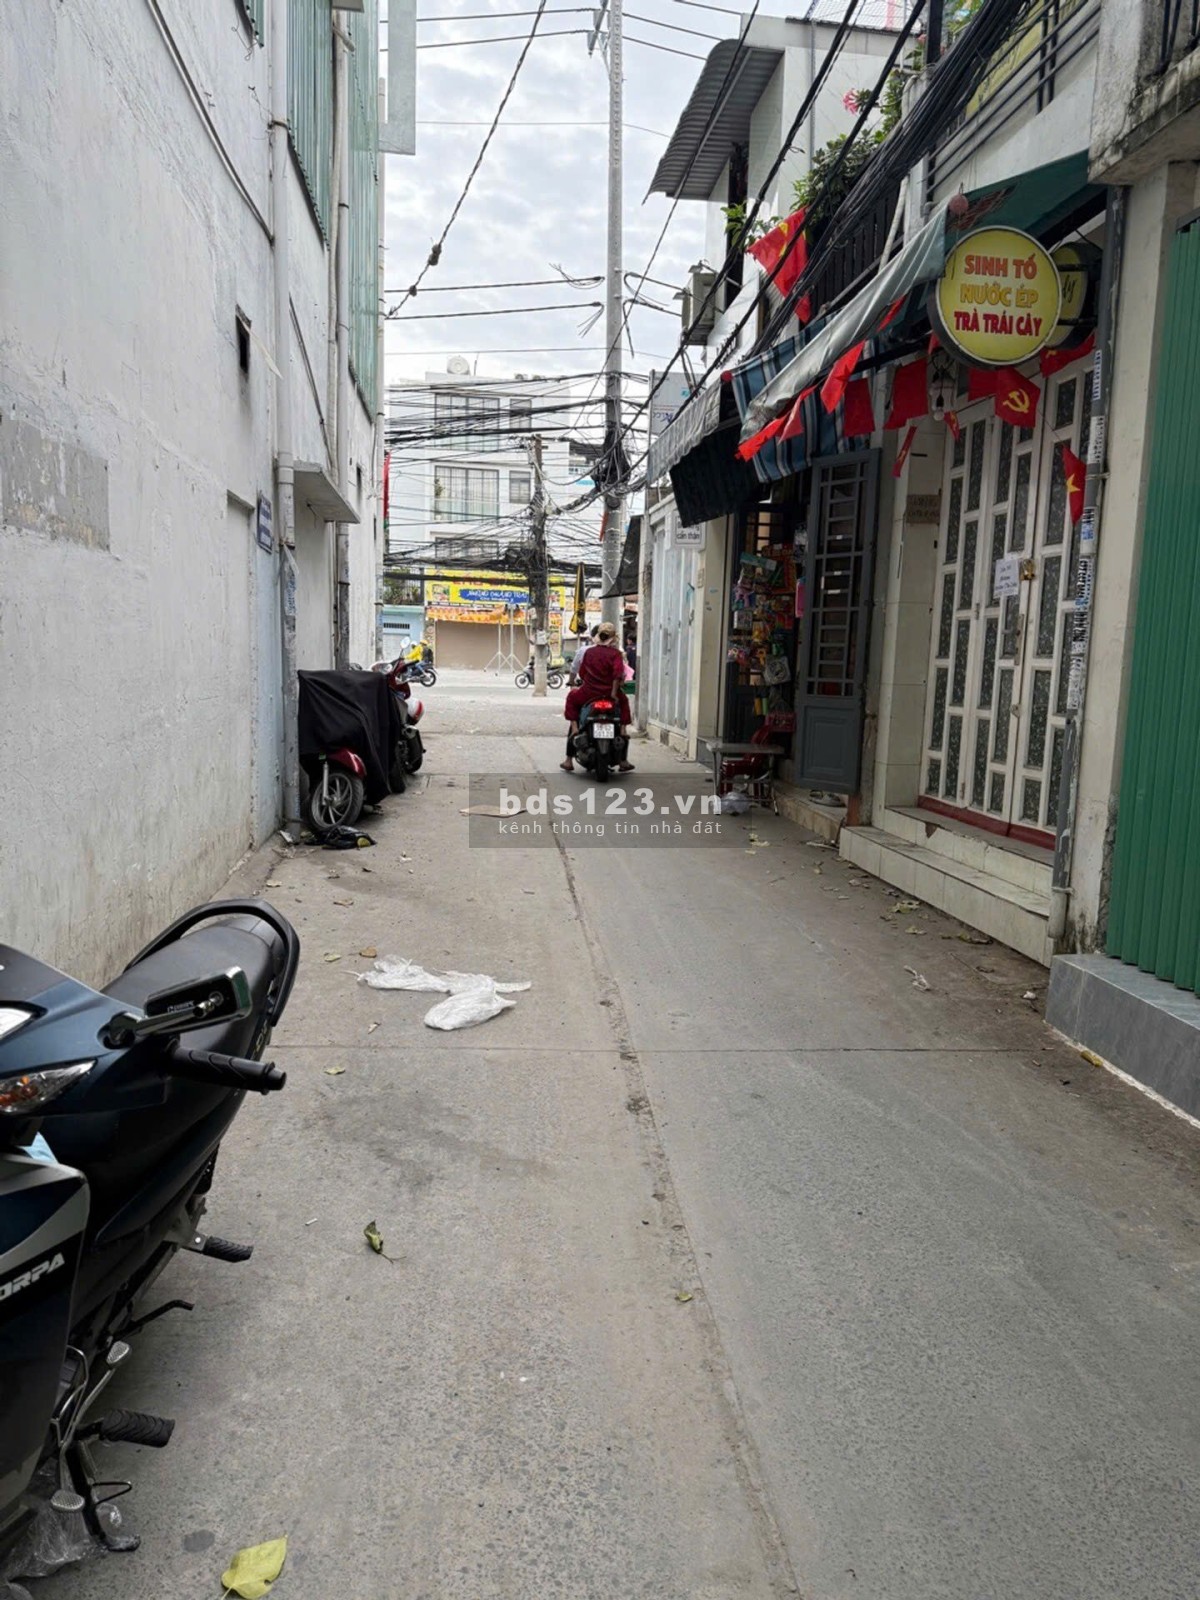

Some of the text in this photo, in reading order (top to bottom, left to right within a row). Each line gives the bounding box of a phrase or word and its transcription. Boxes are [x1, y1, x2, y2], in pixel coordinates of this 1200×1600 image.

[964, 252, 1038, 280] SINH TỐ
[960, 281, 1012, 307] NƯỚC
[1015, 283, 1039, 308] ÉP
[953, 307, 1043, 337] TRÀ TRÁI CÂY
